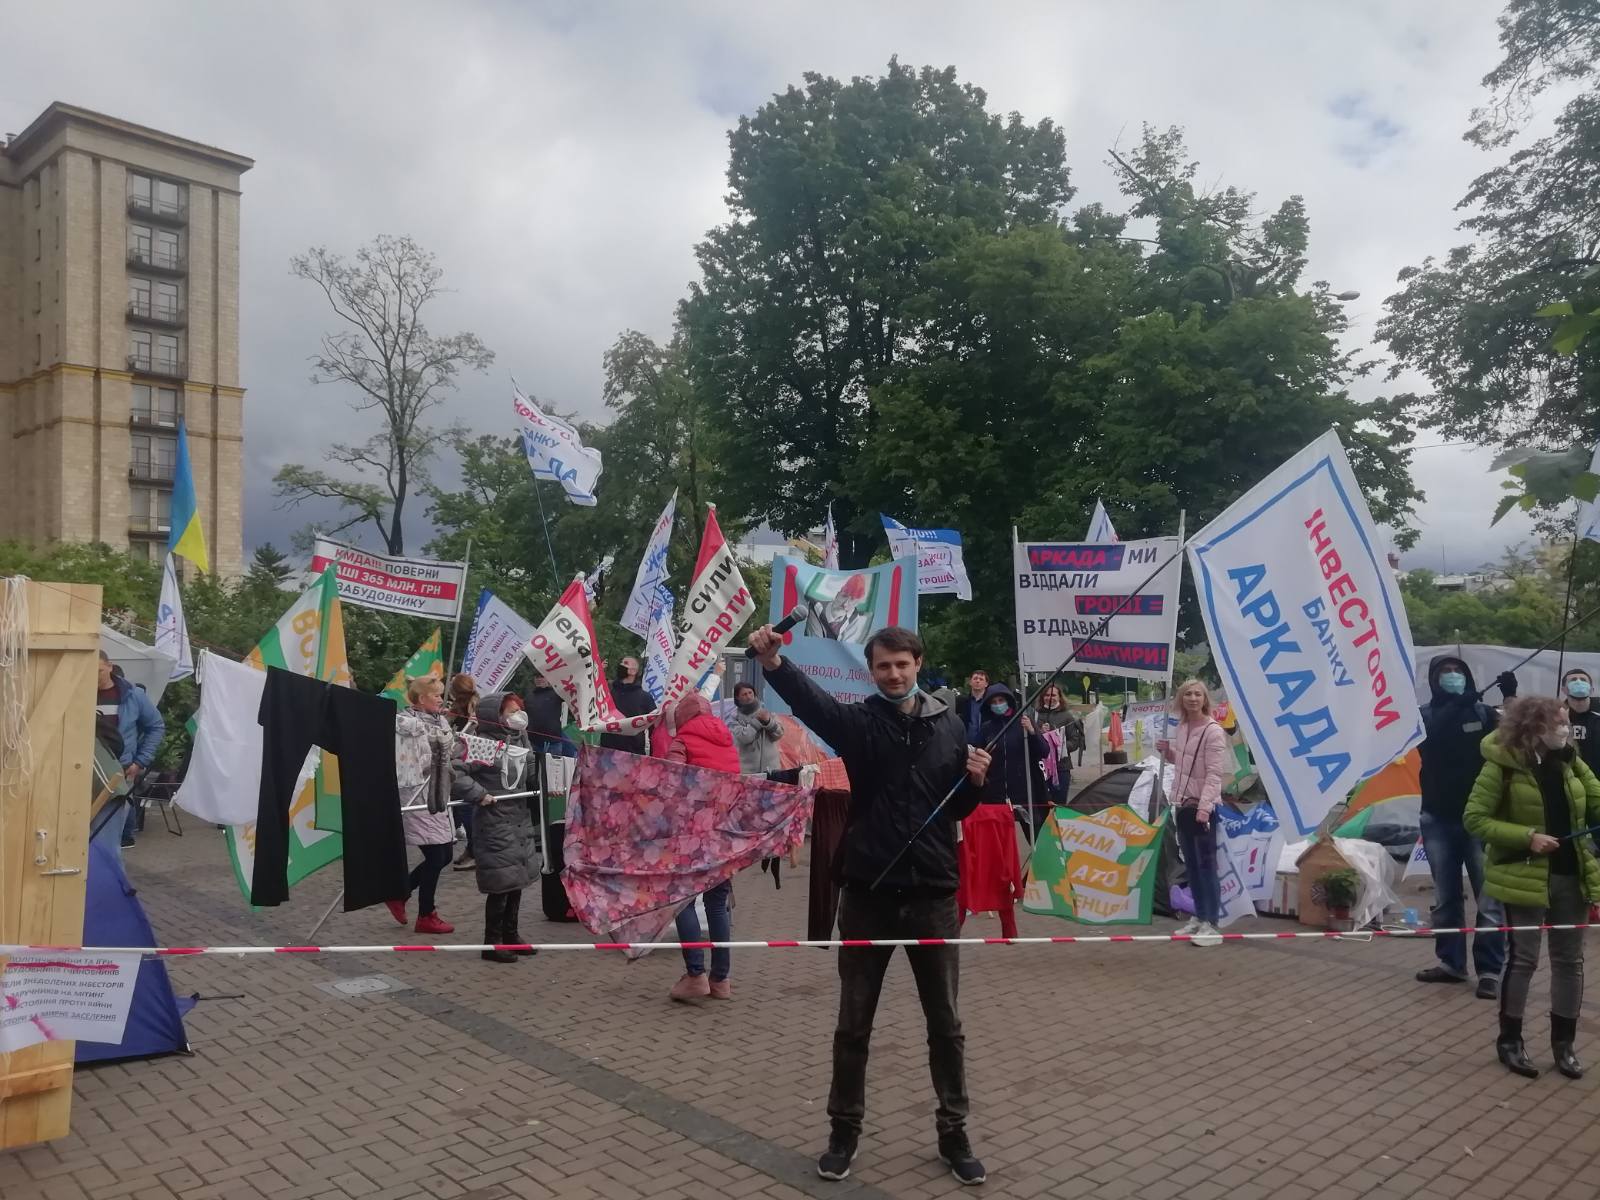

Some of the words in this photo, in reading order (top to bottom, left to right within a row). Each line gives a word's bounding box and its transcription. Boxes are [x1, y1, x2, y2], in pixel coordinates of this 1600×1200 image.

[335, 548, 384, 570] КМДА!!!
[385, 563, 440, 580] ПОВЕРНИ
[1031, 551, 1106, 569] АРКАДА
[1128, 547, 1158, 565] МИ
[336, 582, 426, 608] ЗАБУДОВНИКУ
[361, 571, 385, 586] 365
[386, 577, 418, 593] МЛН.
[421, 583, 441, 595] ГРН
[690, 554, 738, 614] сили
[1019, 573, 1099, 591] ВІДДАЛИ
[1076, 595, 1142, 613] ГРОШІ
[1023, 617, 1110, 637] ВІДДАВАЙ
[1304, 507, 1400, 731] ІНВЕСТОРИ
[1072, 639, 1168, 665] КВАРТИРИ!
[1302, 595, 1355, 688] БАНКУ
[1227, 563, 1352, 793] АРКАДА
[1072, 865, 1119, 889] АТО
